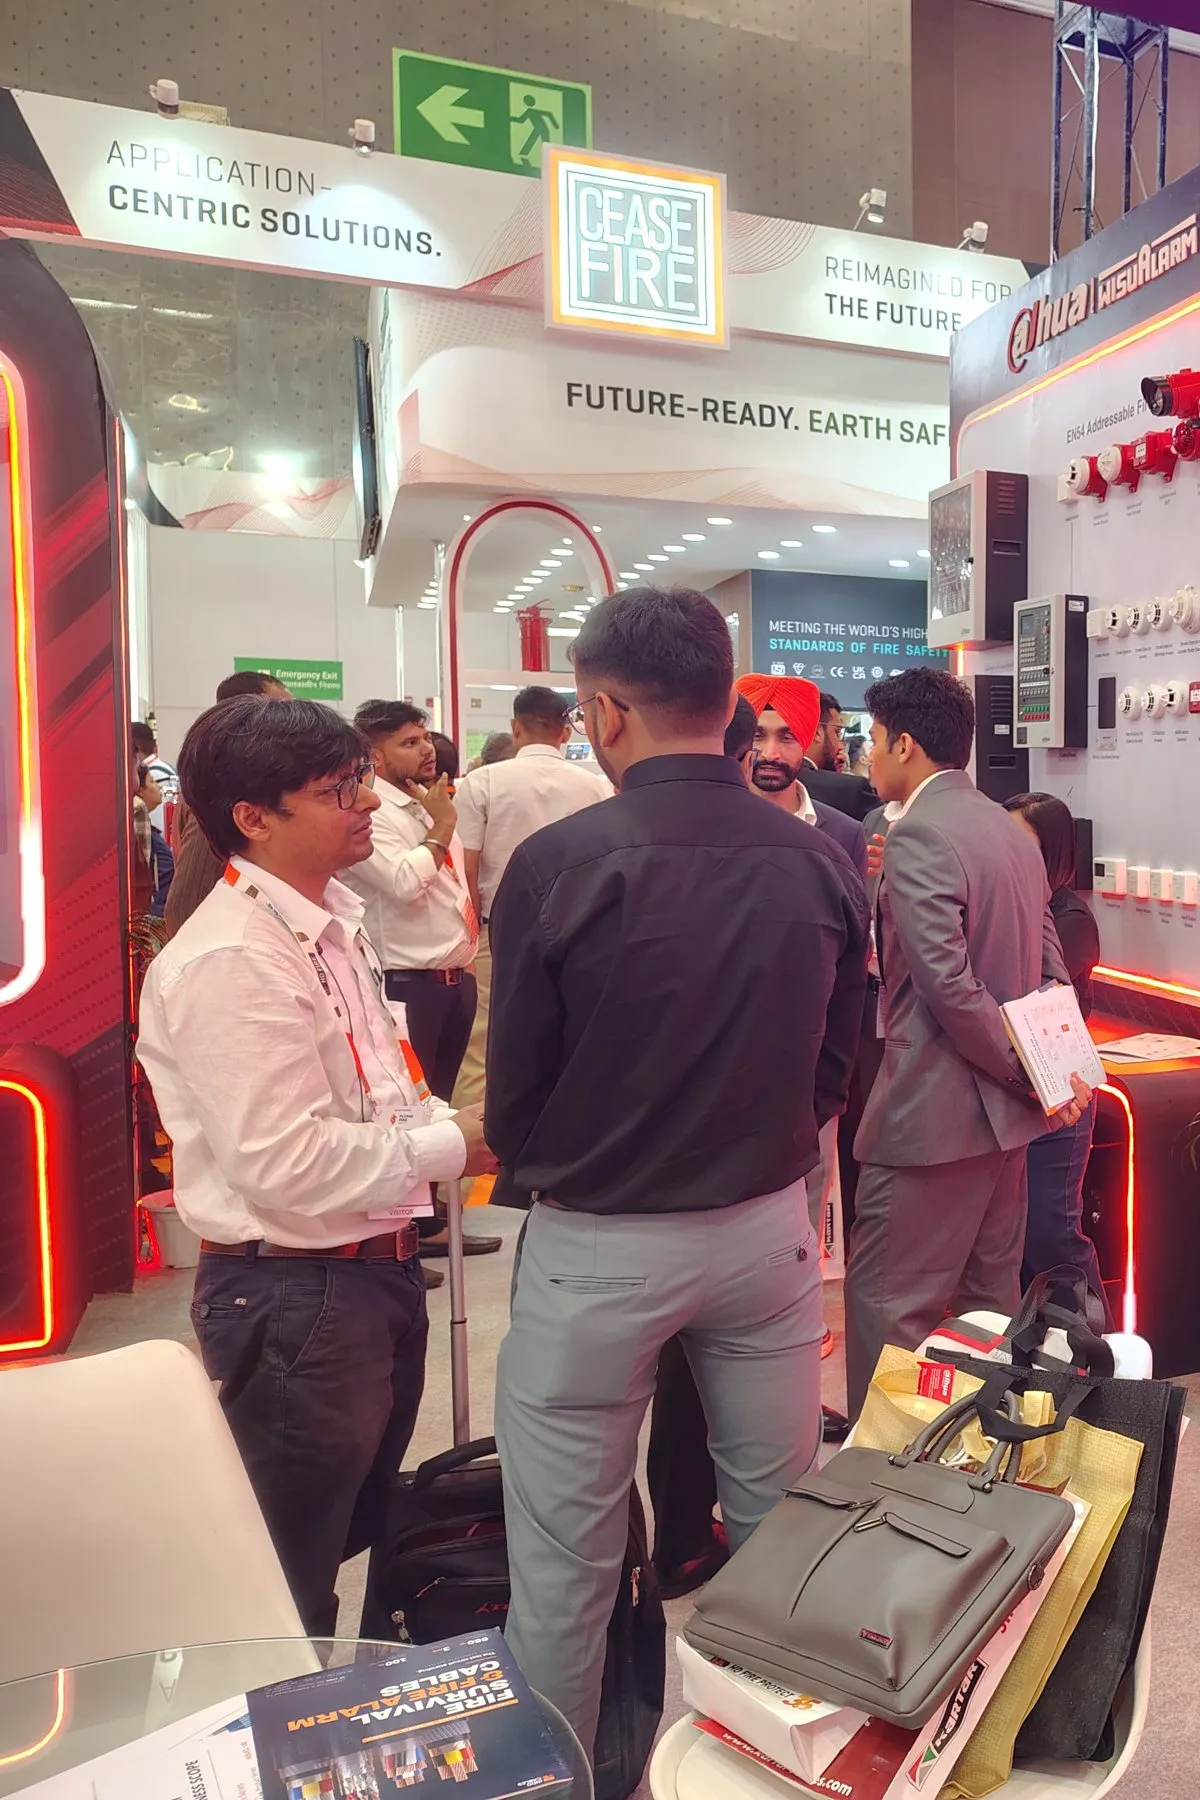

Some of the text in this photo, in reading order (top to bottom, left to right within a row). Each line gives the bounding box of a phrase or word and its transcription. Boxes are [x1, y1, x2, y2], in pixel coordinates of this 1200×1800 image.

[106, 139, 332, 197] APPLICATION-
[108, 185, 443, 258] CENTRIC SOLUTIONS.
[579, 189, 692, 247] CEASE
[580, 246, 695, 312] FIRE
[825, 256, 1012, 303] REIMAGINED FOR
[825, 293, 962, 332] THE FUTURE
[566, 382, 950, 447] FUTURE-READY. EARTH SAF
[1067, 425, 1085, 444] EN54
[1087, 404, 1140, 437] Addressable
[769, 620, 928, 639] MEETING THE WORLD'S HIGH
[769, 638, 949, 657] STANDARDS OF FIRE SAFETY
[276, 669, 338, 680] Emergency Exit
[380, 1660, 500, 1697] CABLES
[401, 1676, 477, 1701] FIRE
[742, 1669, 760, 1681] FIRE
[759, 1678, 796, 1698] PROTECT
[287, 1692, 400, 1731] ALARM
[350, 1679, 510, 1726] SURVIVAL
[446, 1689, 514, 1715] FIRE
[185, 1760, 203, 1784] SCOPE
